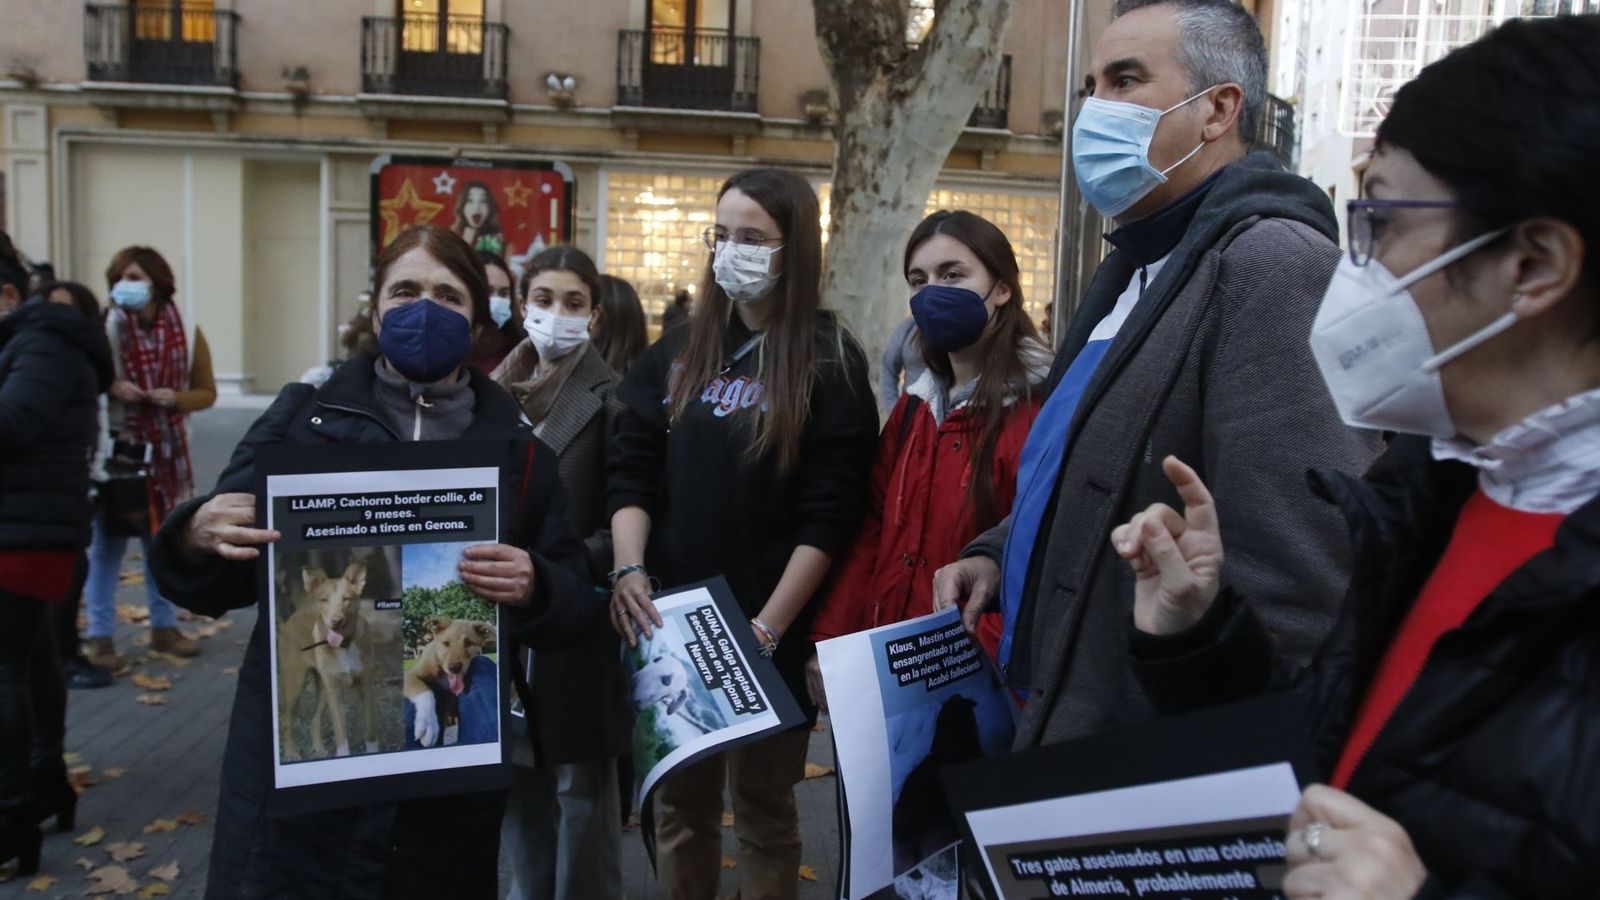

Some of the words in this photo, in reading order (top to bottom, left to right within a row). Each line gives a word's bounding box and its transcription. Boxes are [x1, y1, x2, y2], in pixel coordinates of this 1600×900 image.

[292, 498, 337, 510] LLAMP,
[340, 496, 392, 508] Cachorro
[394, 493, 432, 505] border
[433, 492, 467, 504] collie,
[469, 491, 483, 502] de
[364, 510, 373, 520] 9
[375, 509, 416, 519] meses.
[305, 523, 368, 538] Asesinado
[370, 525, 378, 534] a
[379, 522, 406, 534] tiros
[408, 522, 422, 532] en
[424, 519, 468, 531] Gerona.
[701, 608, 722, 638] DUNA,
[717, 638, 737, 666] Galga
[732, 666, 757, 703] raptada
[889, 642, 916, 655] Klaus,
[893, 644, 949, 669] ensangrentado
[949, 643, 954, 654] y
[689, 615, 718, 660] secuestra
[713, 659, 725, 673] en
[720, 672, 745, 712] Tajonar,
[689, 643, 714, 684] Navarra.
[900, 670, 911, 682] en
[911, 667, 920, 679] la
[920, 661, 942, 675] nieve.
[928, 673, 949, 688] Acabó
[1011, 858, 1043, 875] Tres
[1044, 855, 1081, 876] gatos
[1081, 847, 1163, 870] asesinados
[1163, 848, 1186, 864] en
[1186, 844, 1220, 862] una
[1220, 836, 1286, 860] colonia
[1050, 878, 1069, 896] de
[1070, 875, 1130, 896] Almería,
[1133, 869, 1256, 897] probablemente
